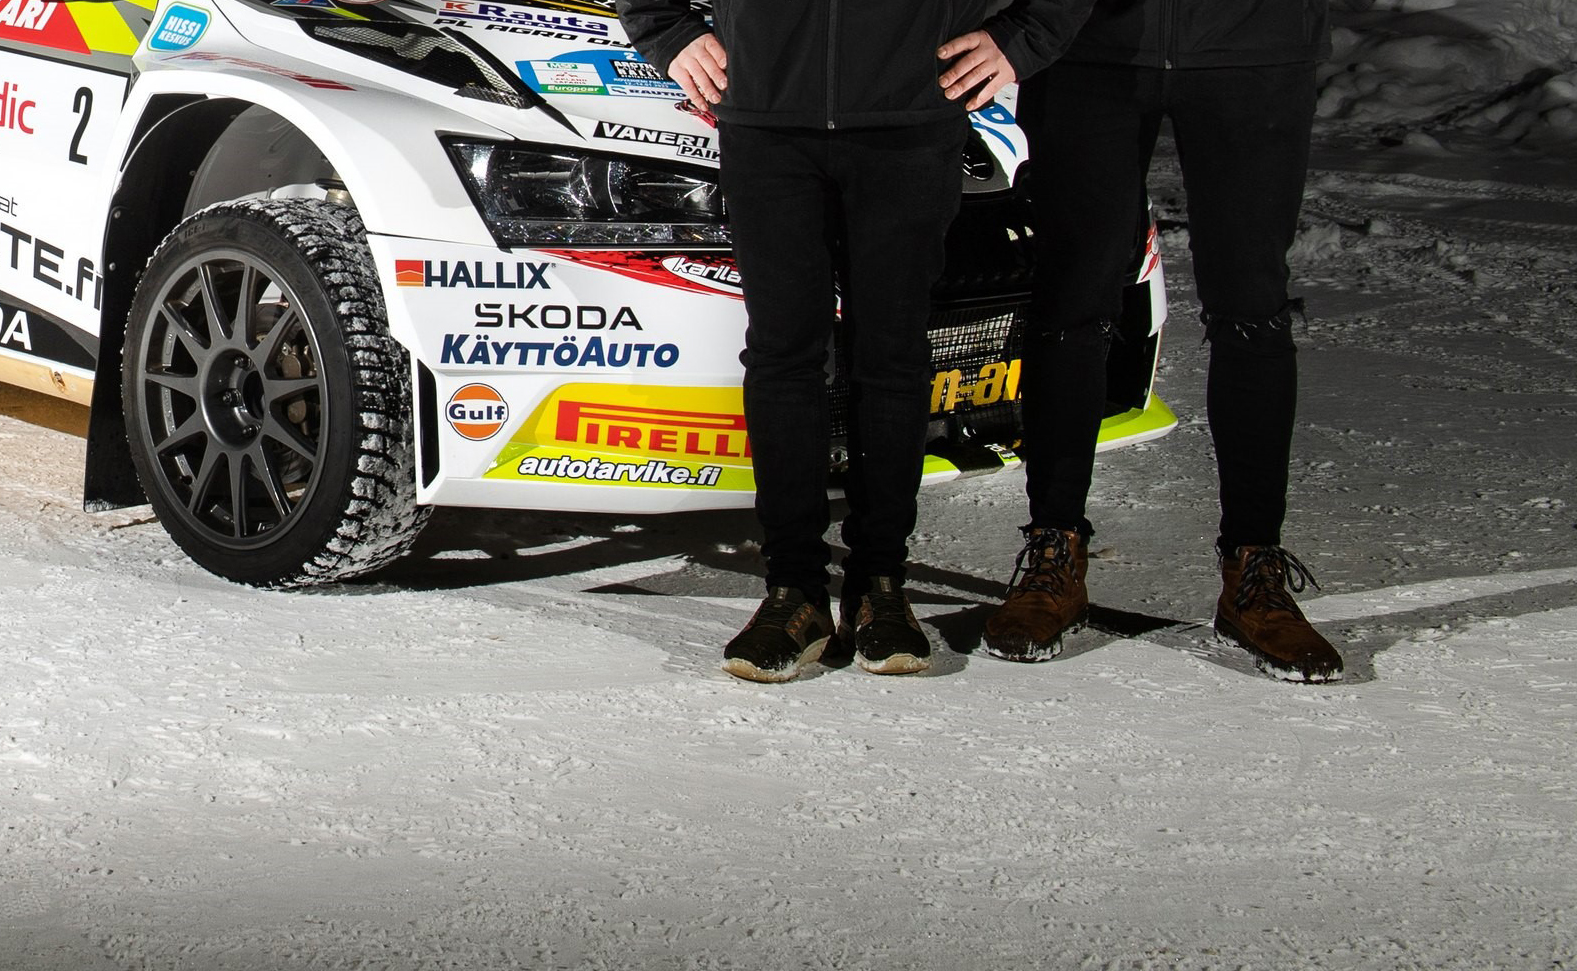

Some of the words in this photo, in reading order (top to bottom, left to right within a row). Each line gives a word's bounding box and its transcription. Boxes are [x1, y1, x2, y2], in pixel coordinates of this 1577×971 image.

[164, 15, 202, 37] HISSI
[433, 18, 473, 29] PL
[485, 23, 578, 41] AGRO
[478, 3, 609, 31] Rauta
[157, 30, 193, 47] KESKUS
[624, 52, 638, 61] 2
[69, 86, 93, 165] 2
[602, 122, 705, 147] VANERI
[425, 261, 552, 290] HALLIX
[672, 256, 742, 284] karila
[448, 403, 506, 422] Gulf
[518, 455, 722, 487] autotarvike.fi
